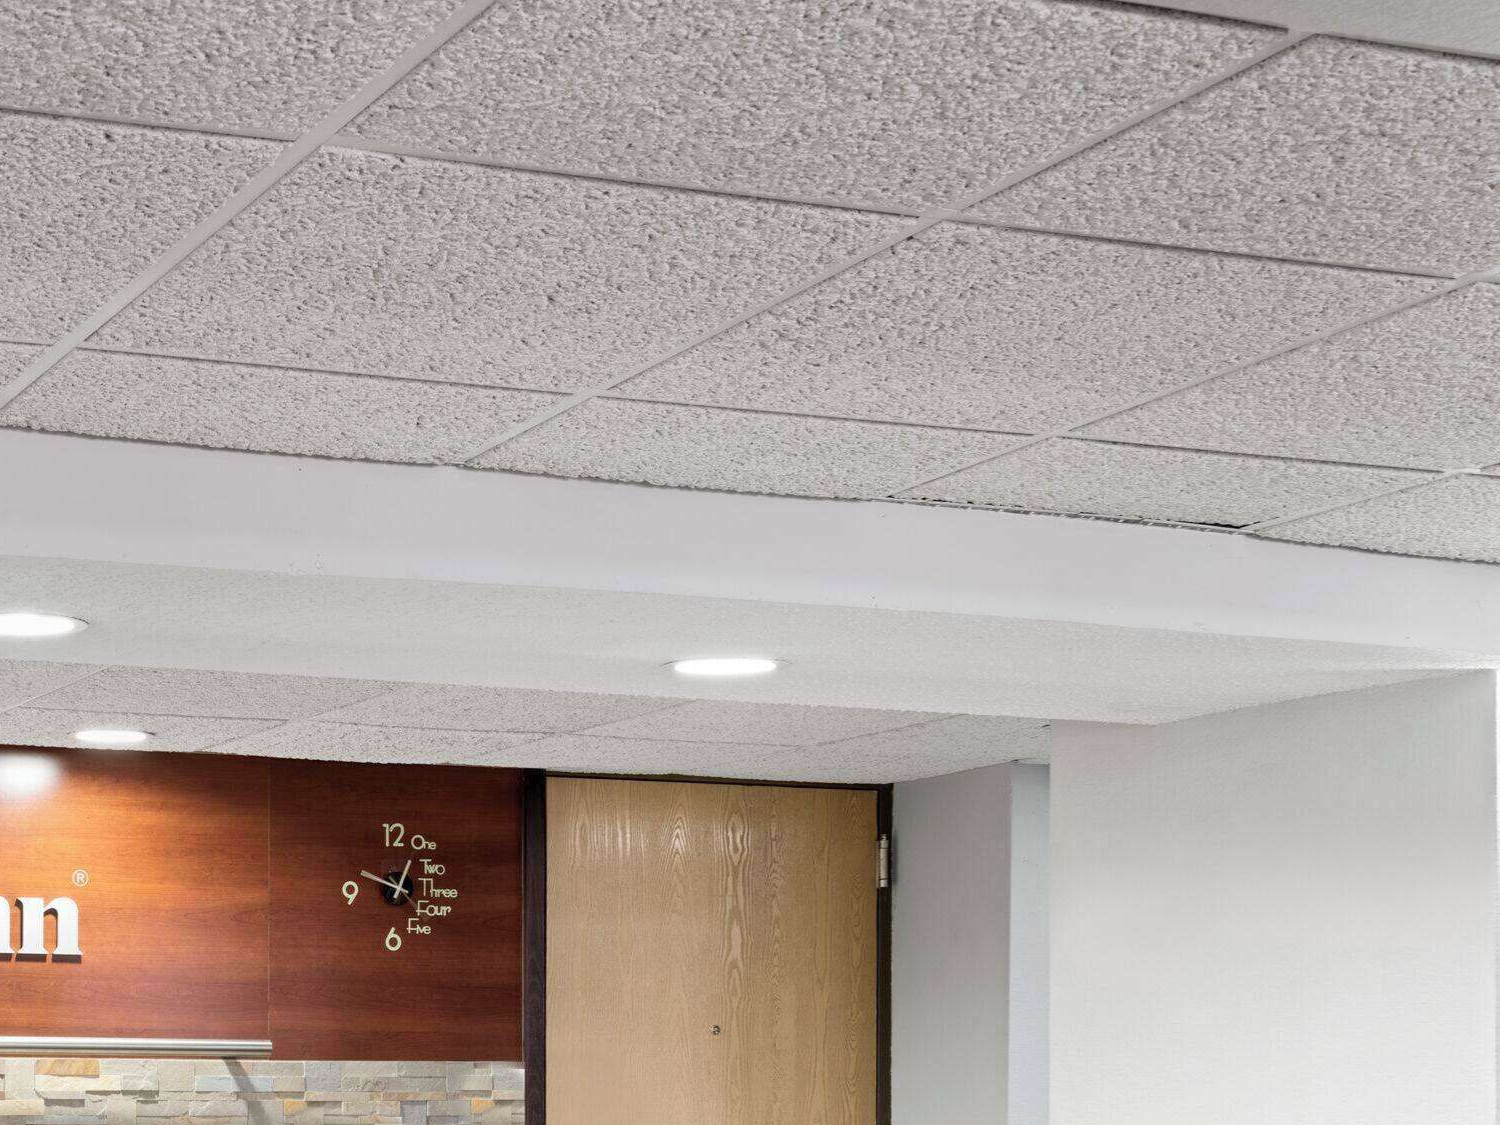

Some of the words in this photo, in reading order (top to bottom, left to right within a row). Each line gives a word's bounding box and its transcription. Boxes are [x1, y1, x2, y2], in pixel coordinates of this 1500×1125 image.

[382, 823, 404, 847] 12
[411, 835, 436, 850] One
[419, 858, 446, 875] Two
[342, 880, 359, 905] 9
[418, 878, 458, 898] Three
[416, 900, 452, 916] Four
[406, 918, 431, 934] Five
[385, 927, 402, 951] 6
